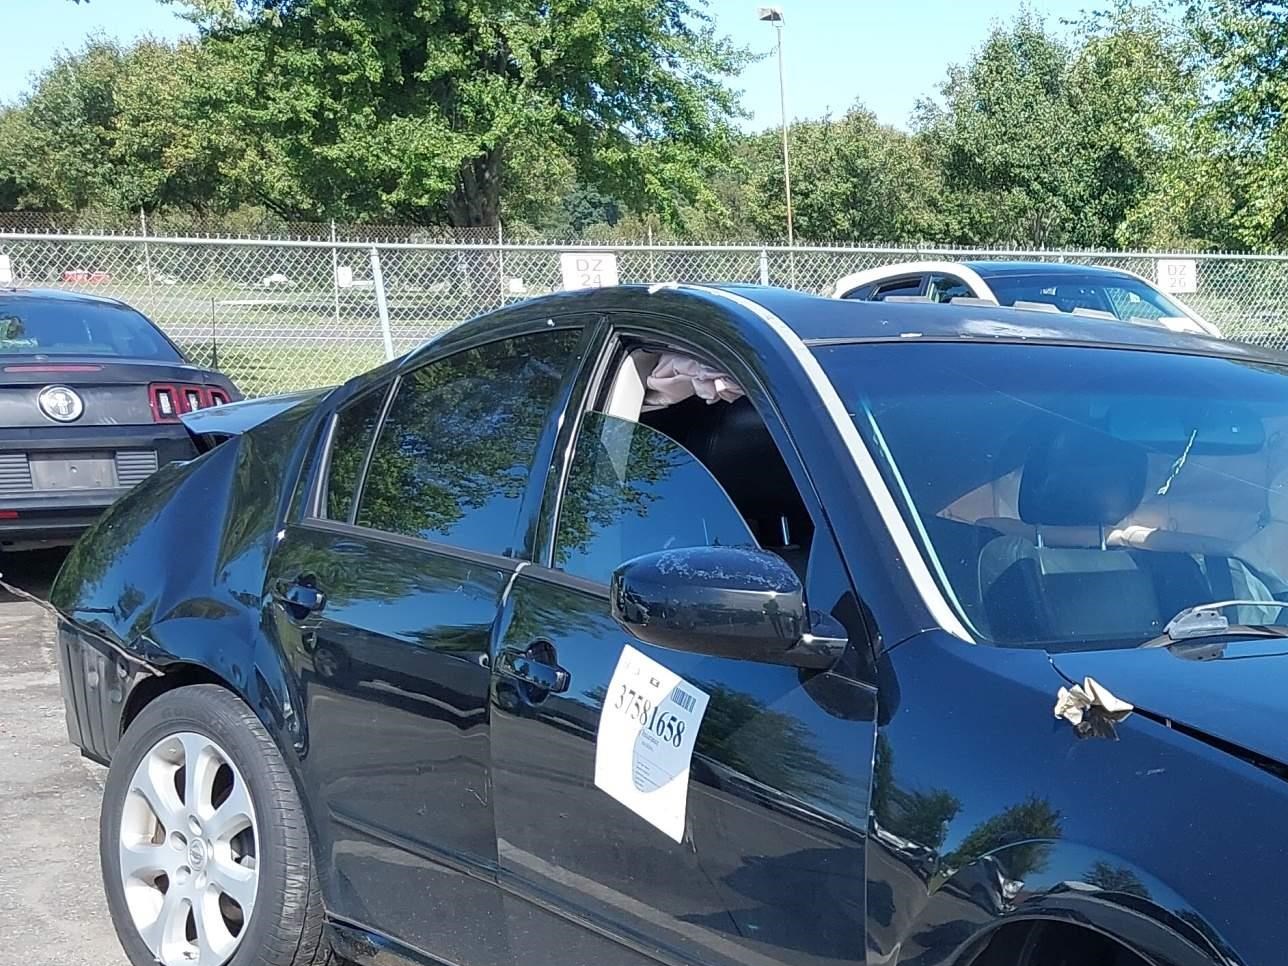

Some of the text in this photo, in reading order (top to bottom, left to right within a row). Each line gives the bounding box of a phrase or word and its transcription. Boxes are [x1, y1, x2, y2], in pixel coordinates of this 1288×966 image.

[576, 258, 603, 271] DZ
[1167, 264, 1186, 275] DZ
[580, 273, 602, 288] 24
[614, 684, 686, 748] 37581658
